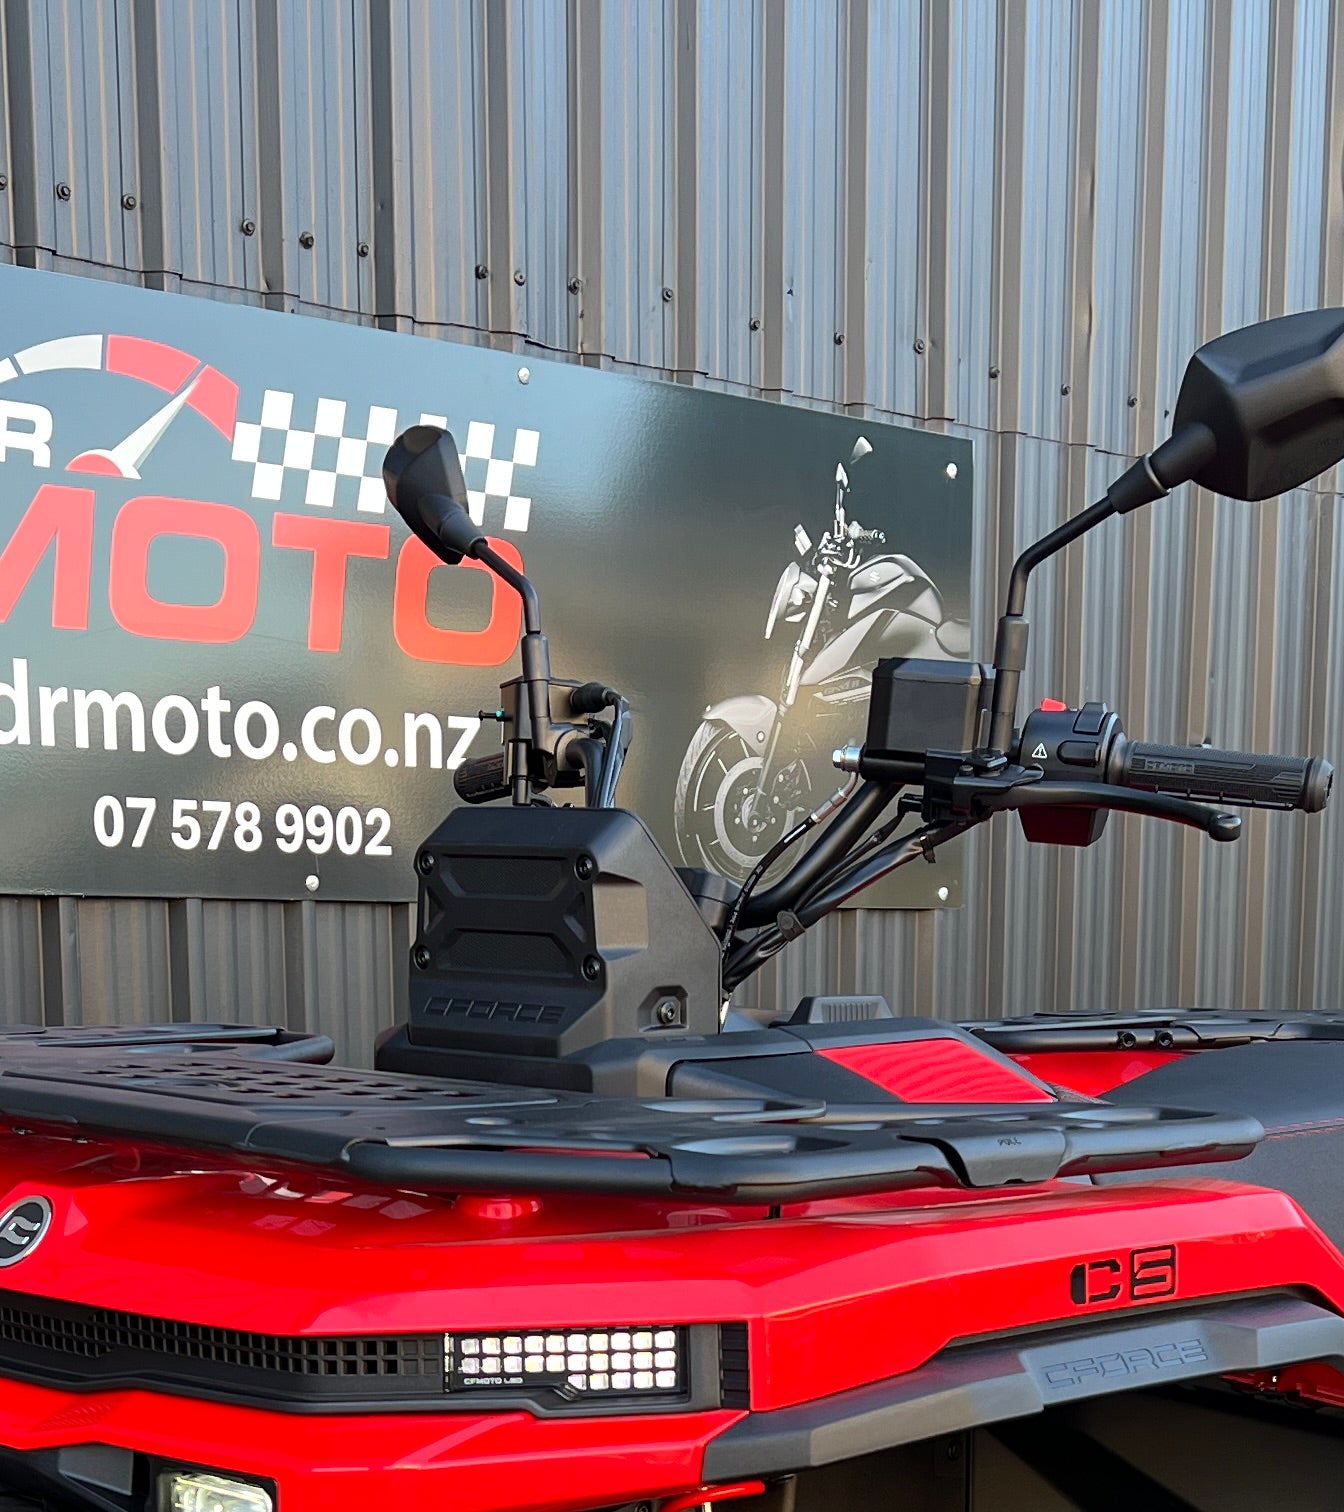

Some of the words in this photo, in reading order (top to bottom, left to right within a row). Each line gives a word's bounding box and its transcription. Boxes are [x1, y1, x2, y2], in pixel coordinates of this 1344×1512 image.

[93, 796, 156, 848] 07
[171, 799, 263, 853] 578
[275, 803, 393, 857] 9902
[423, 997, 565, 1024] CFORCE
[1040, 1338, 1208, 1389] CFORCE
